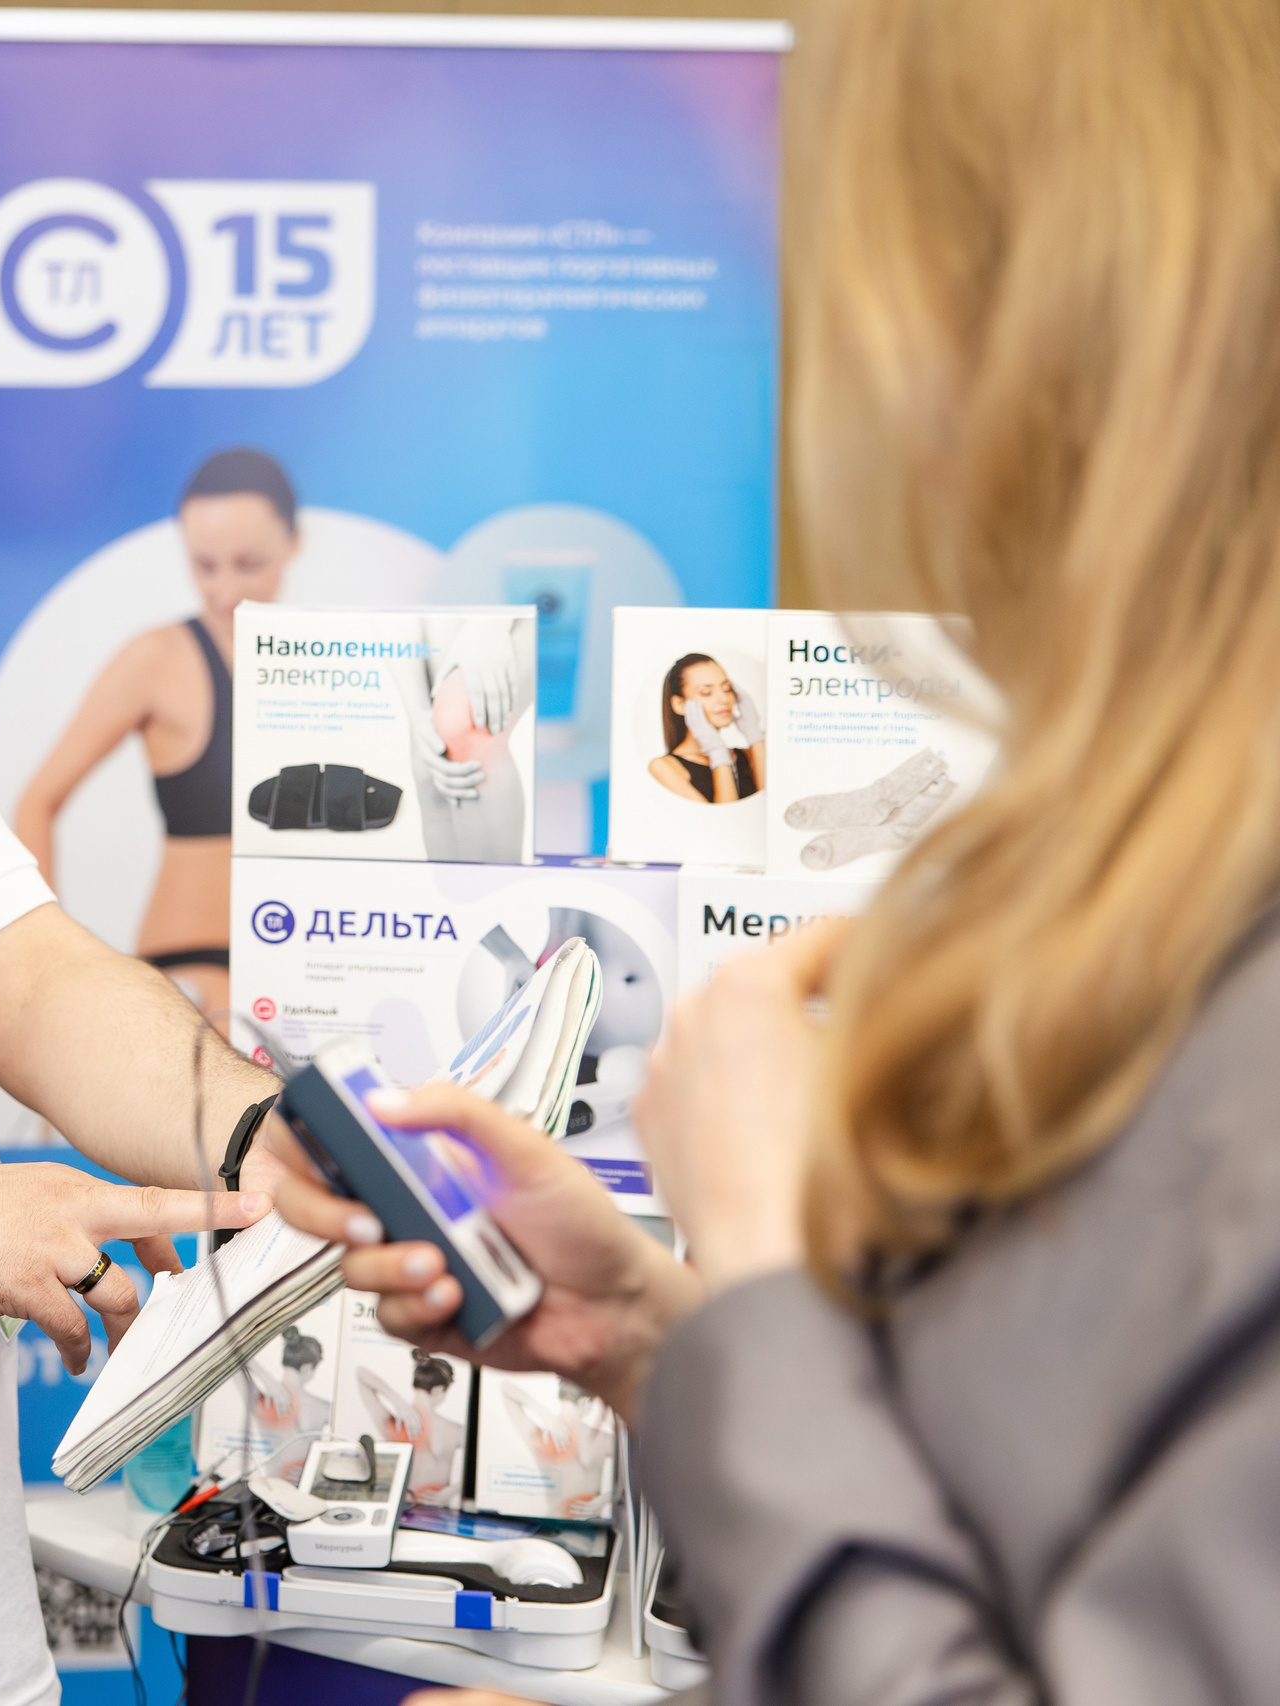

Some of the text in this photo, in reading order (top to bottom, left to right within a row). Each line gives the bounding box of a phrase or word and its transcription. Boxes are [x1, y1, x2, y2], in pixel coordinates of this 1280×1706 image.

[211, 212, 333, 299] 15
[212, 310, 332, 358] ЛЕТ
[256, 635, 441, 659] Наколенник-
[256, 667, 381, 691] электрод
[789, 676, 961, 703] электроды
[306, 909, 458, 943] ДЕЛЬТА
